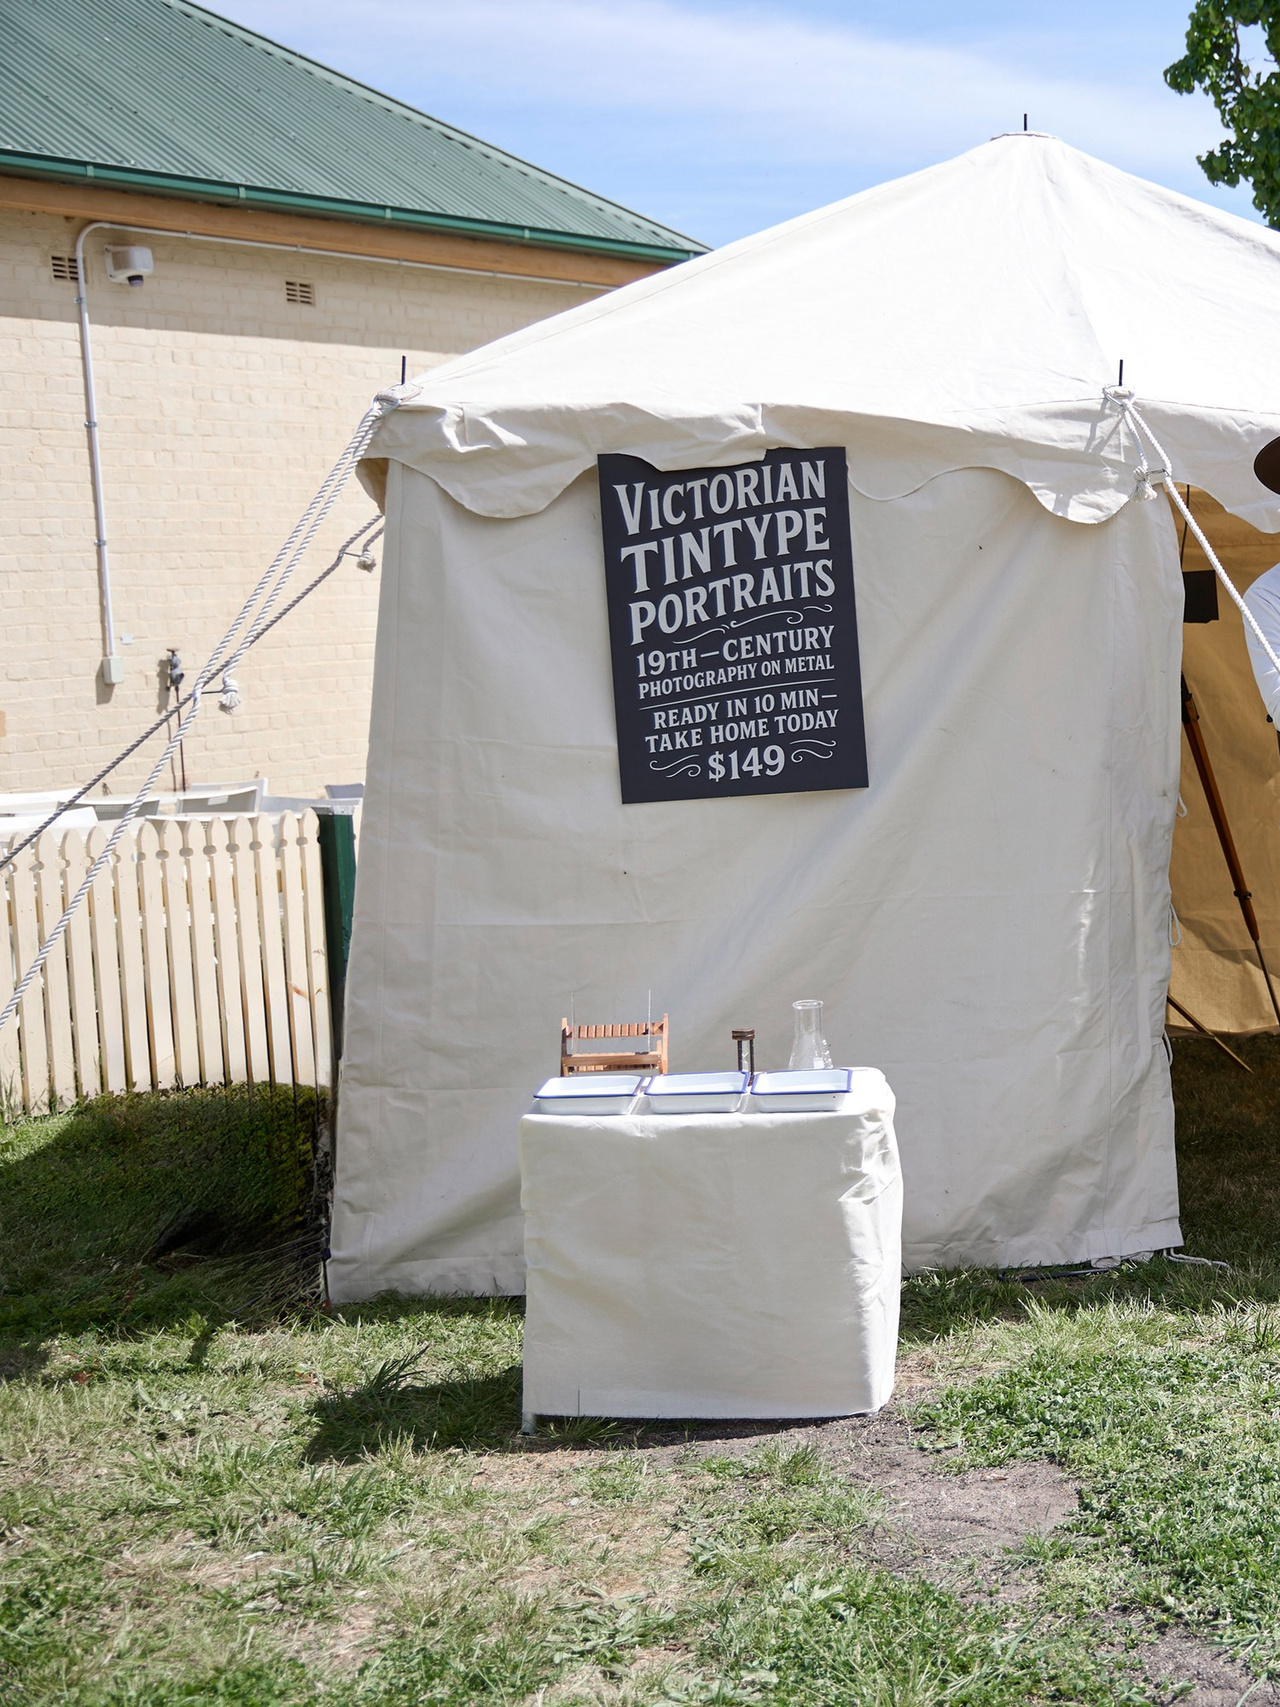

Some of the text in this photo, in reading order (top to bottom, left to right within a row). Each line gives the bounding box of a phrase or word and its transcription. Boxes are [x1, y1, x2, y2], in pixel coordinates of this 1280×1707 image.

[613, 461, 826, 535] VICTORIAN
[621, 507, 830, 594] TINTYPE
[628, 559, 835, 645] PORTRAITS
[639, 655, 834, 699] PHOTOGRAPHY ON METAL
[645, 709, 839, 753] TAKE HOME TODAY
[654, 702, 720, 730] READY
[727, 699, 747, 719] IN
[755, 694, 774, 714] 10
[708, 745, 785, 782] $149
